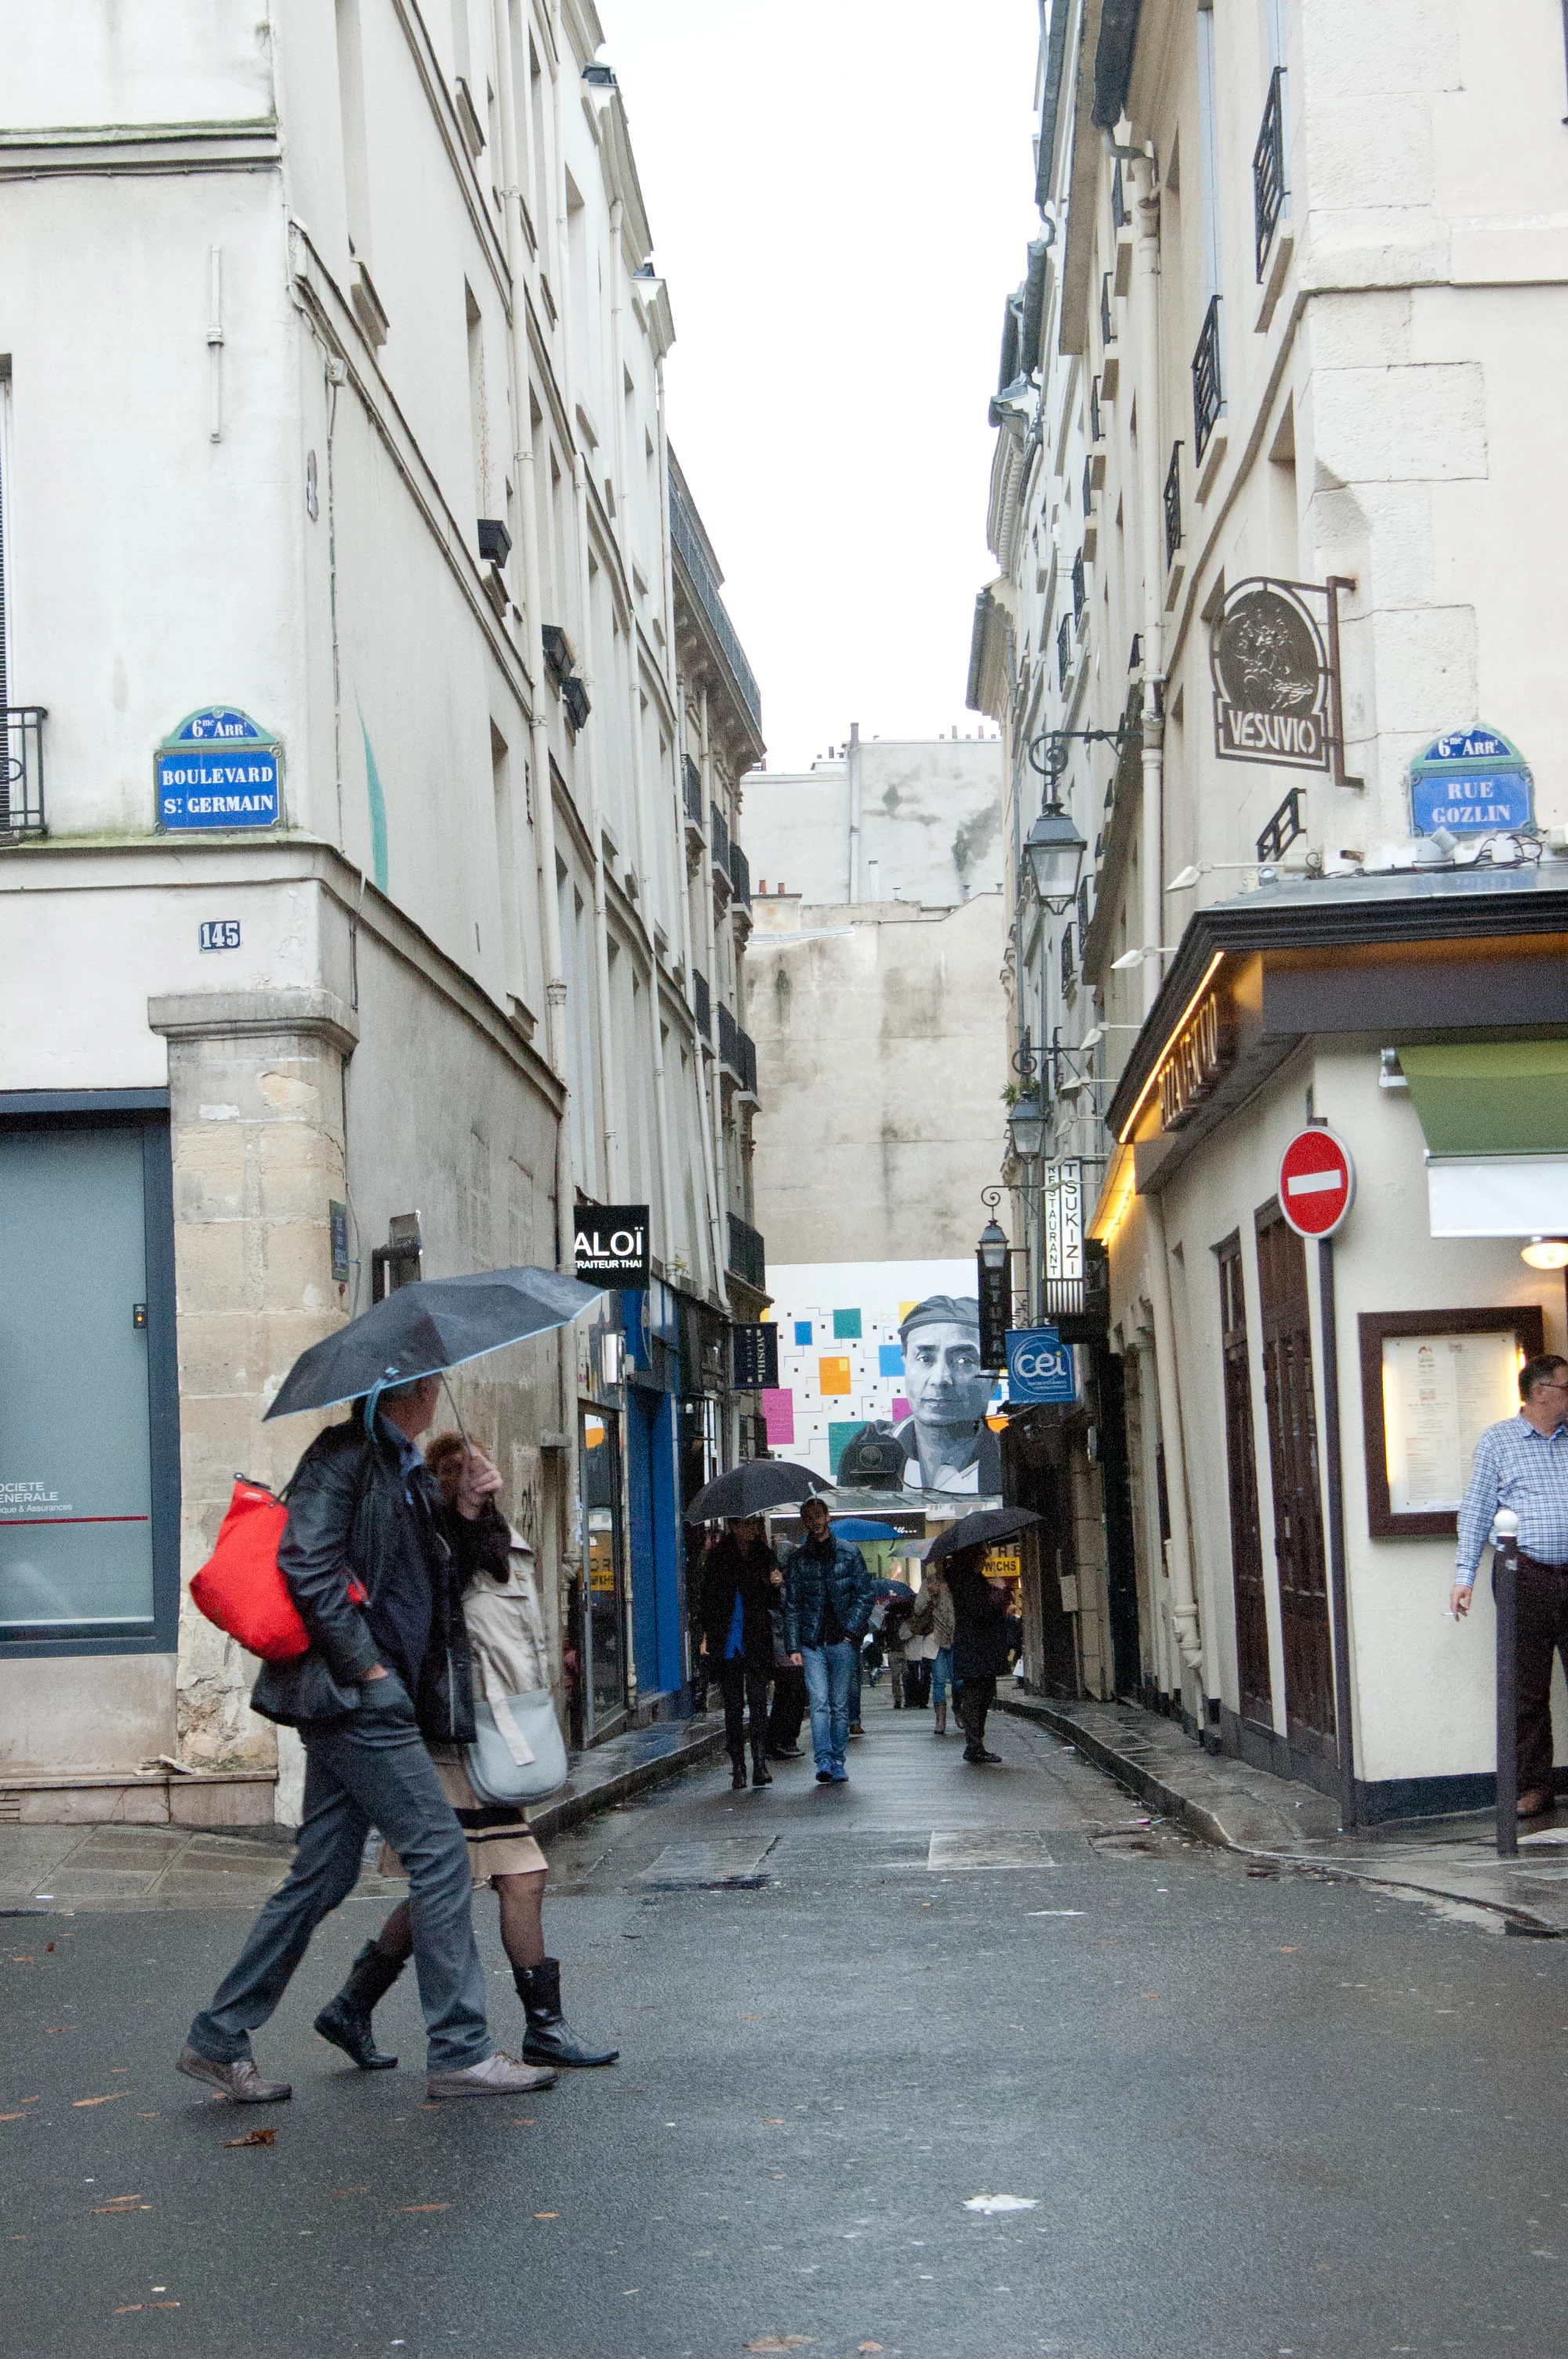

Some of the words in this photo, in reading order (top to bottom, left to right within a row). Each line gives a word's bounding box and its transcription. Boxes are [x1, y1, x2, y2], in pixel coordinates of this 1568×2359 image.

[1228, 710, 1316, 754] VESUVIO
[162, 766, 273, 786] BOULEVARD
[1447, 781, 1494, 799] RUE
[187, 795, 274, 813] GERMAIN
[1432, 805, 1511, 823] GOZLIN
[201, 921, 240, 949] 145
[1047, 1166, 1058, 1274] RESTAURANT
[1064, 1163, 1080, 1275] TSUKIZI
[574, 1226, 644, 1256] ALOÏ
[619, 1259, 642, 1268] THAI
[1017, 1350, 1067, 1378] cei
[0, 1481, 45, 1492] OCIETE
[0, 1492, 59, 1503] ENERALE
[26, 1504, 74, 1514] Assurances
[981, 1561, 1017, 1572] WICHS
